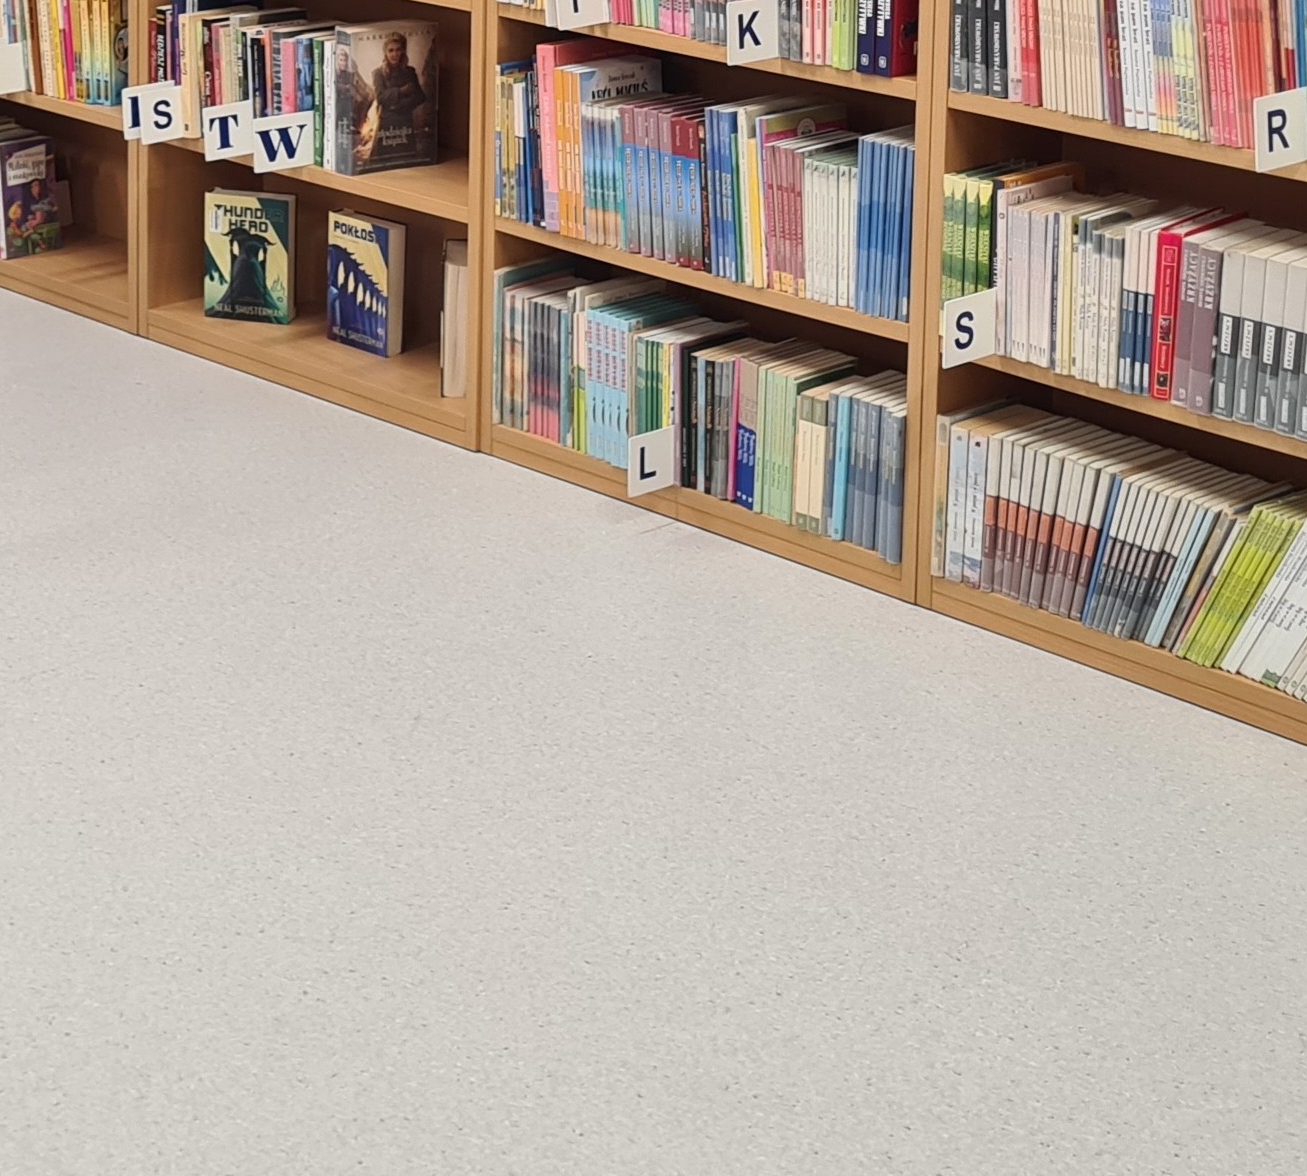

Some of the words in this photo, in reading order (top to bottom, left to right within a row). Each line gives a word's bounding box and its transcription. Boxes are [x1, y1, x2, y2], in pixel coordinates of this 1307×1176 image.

[737, 10, 762, 50] K
[153, 99, 173, 130] S
[208, 113, 239, 150] T
[1267, 108, 1290, 153] R
[255, 123, 306, 163] W
[228, 219, 269, 233] HEAD
[954, 310, 974, 350] S
[639, 446, 657, 481] L
